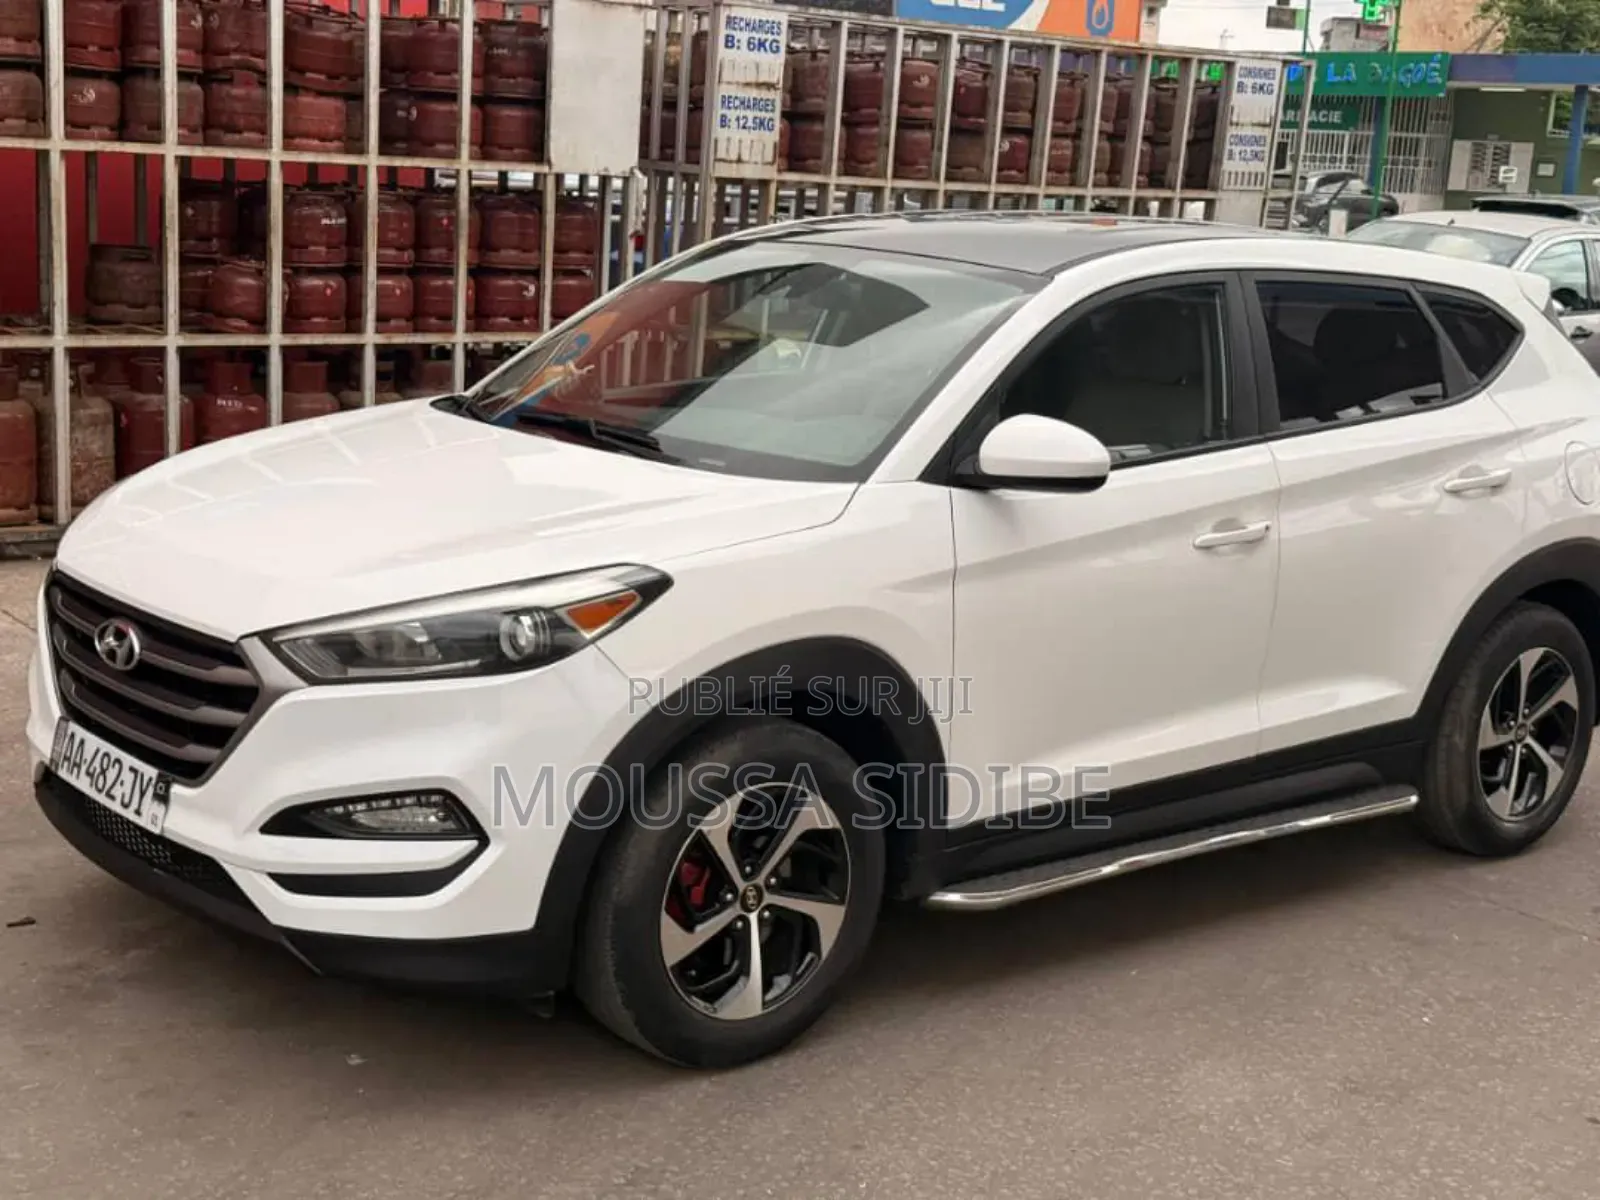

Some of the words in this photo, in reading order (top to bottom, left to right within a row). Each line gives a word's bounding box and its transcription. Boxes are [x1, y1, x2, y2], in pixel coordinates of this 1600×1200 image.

[725, 15, 782, 36] RECHARGES
[724, 34, 741, 50] B:
[747, 36, 781, 54] 6KG
[1327, 62, 1357, 82] LA
[1236, 81, 1248, 94] B:
[1251, 82, 1275, 95] 6KG
[720, 95, 776, 113] RECHARGES
[719, 114, 731, 129] B:
